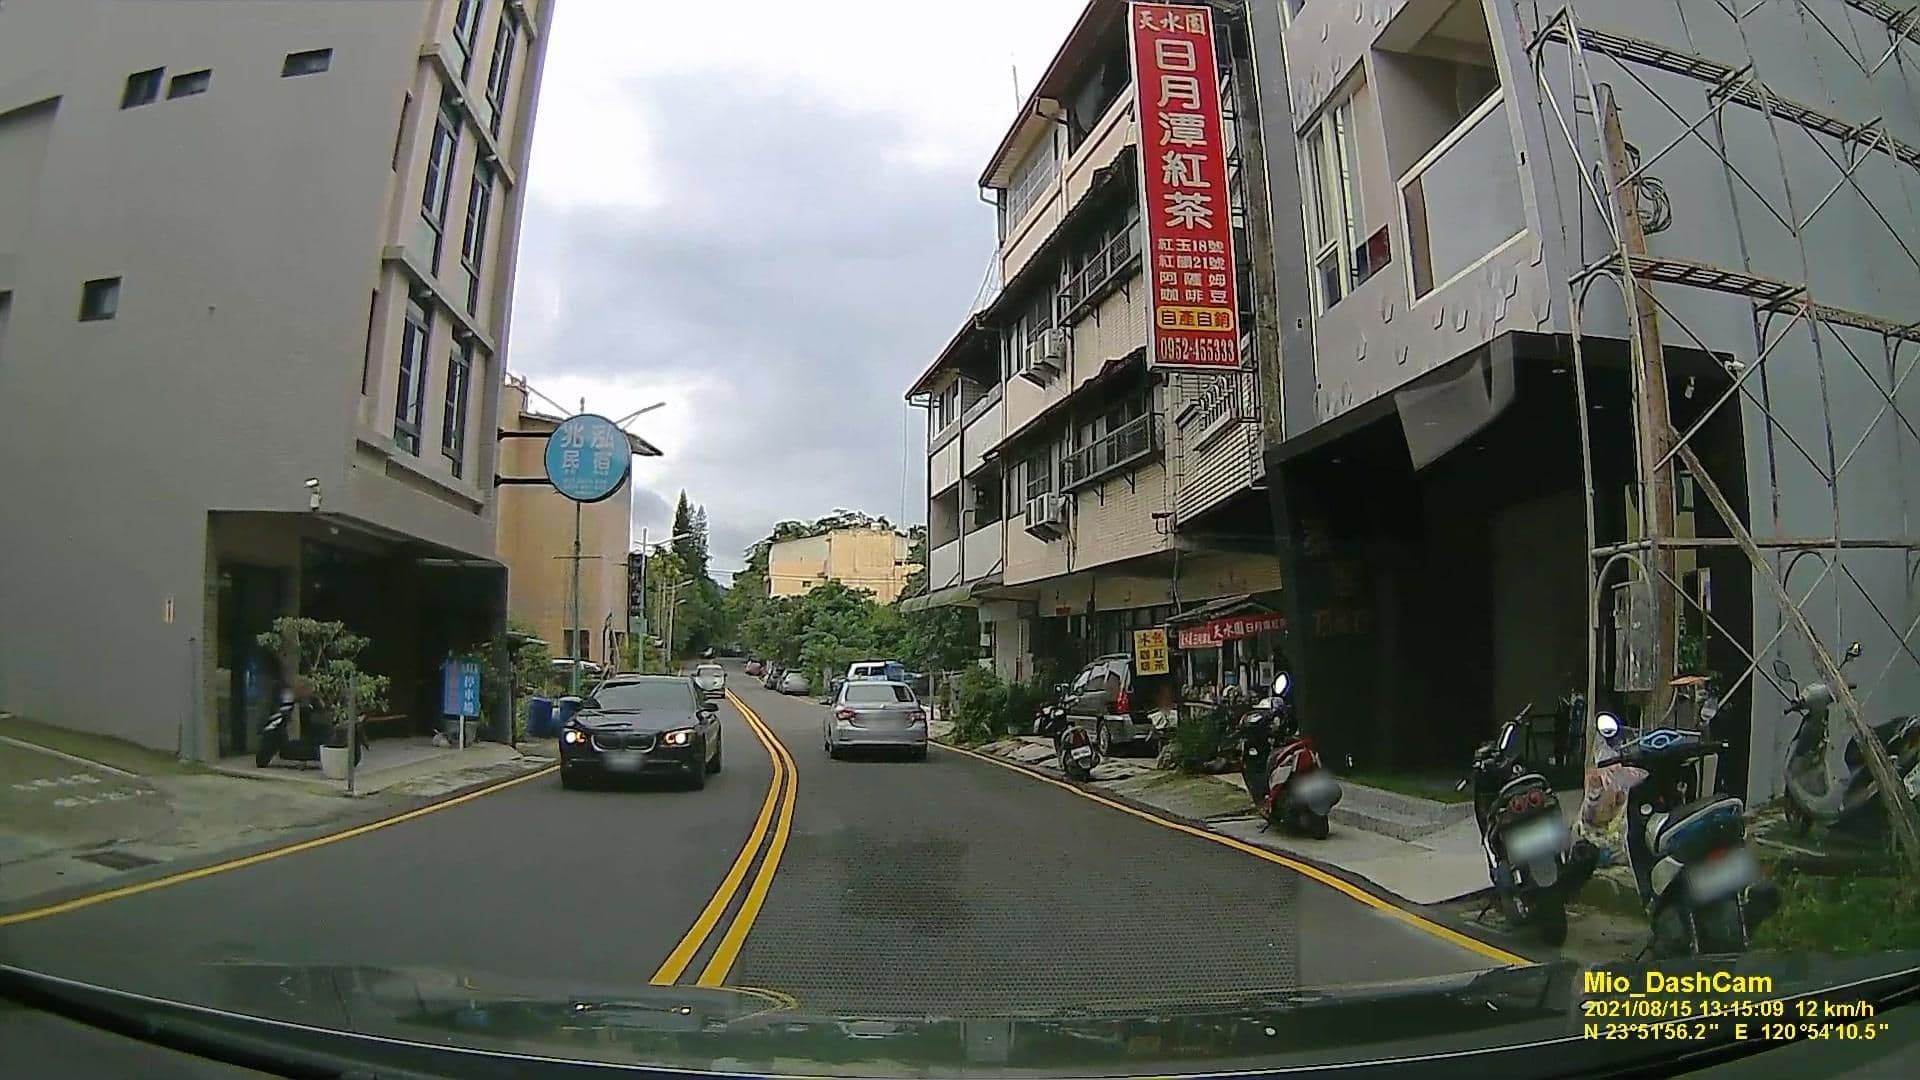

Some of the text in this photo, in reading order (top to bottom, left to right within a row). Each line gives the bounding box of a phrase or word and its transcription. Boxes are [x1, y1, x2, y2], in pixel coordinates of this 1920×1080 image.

[1154, 37, 1214, 232] 日月潭紅茶
[1158, 238, 1225, 254] 紅玉18號
[1160, 287, 1228, 304] 咖啡豆
[1161, 310, 1231, 329] 自產自銷
[1160, 336, 1235, 362] 0952-455333
